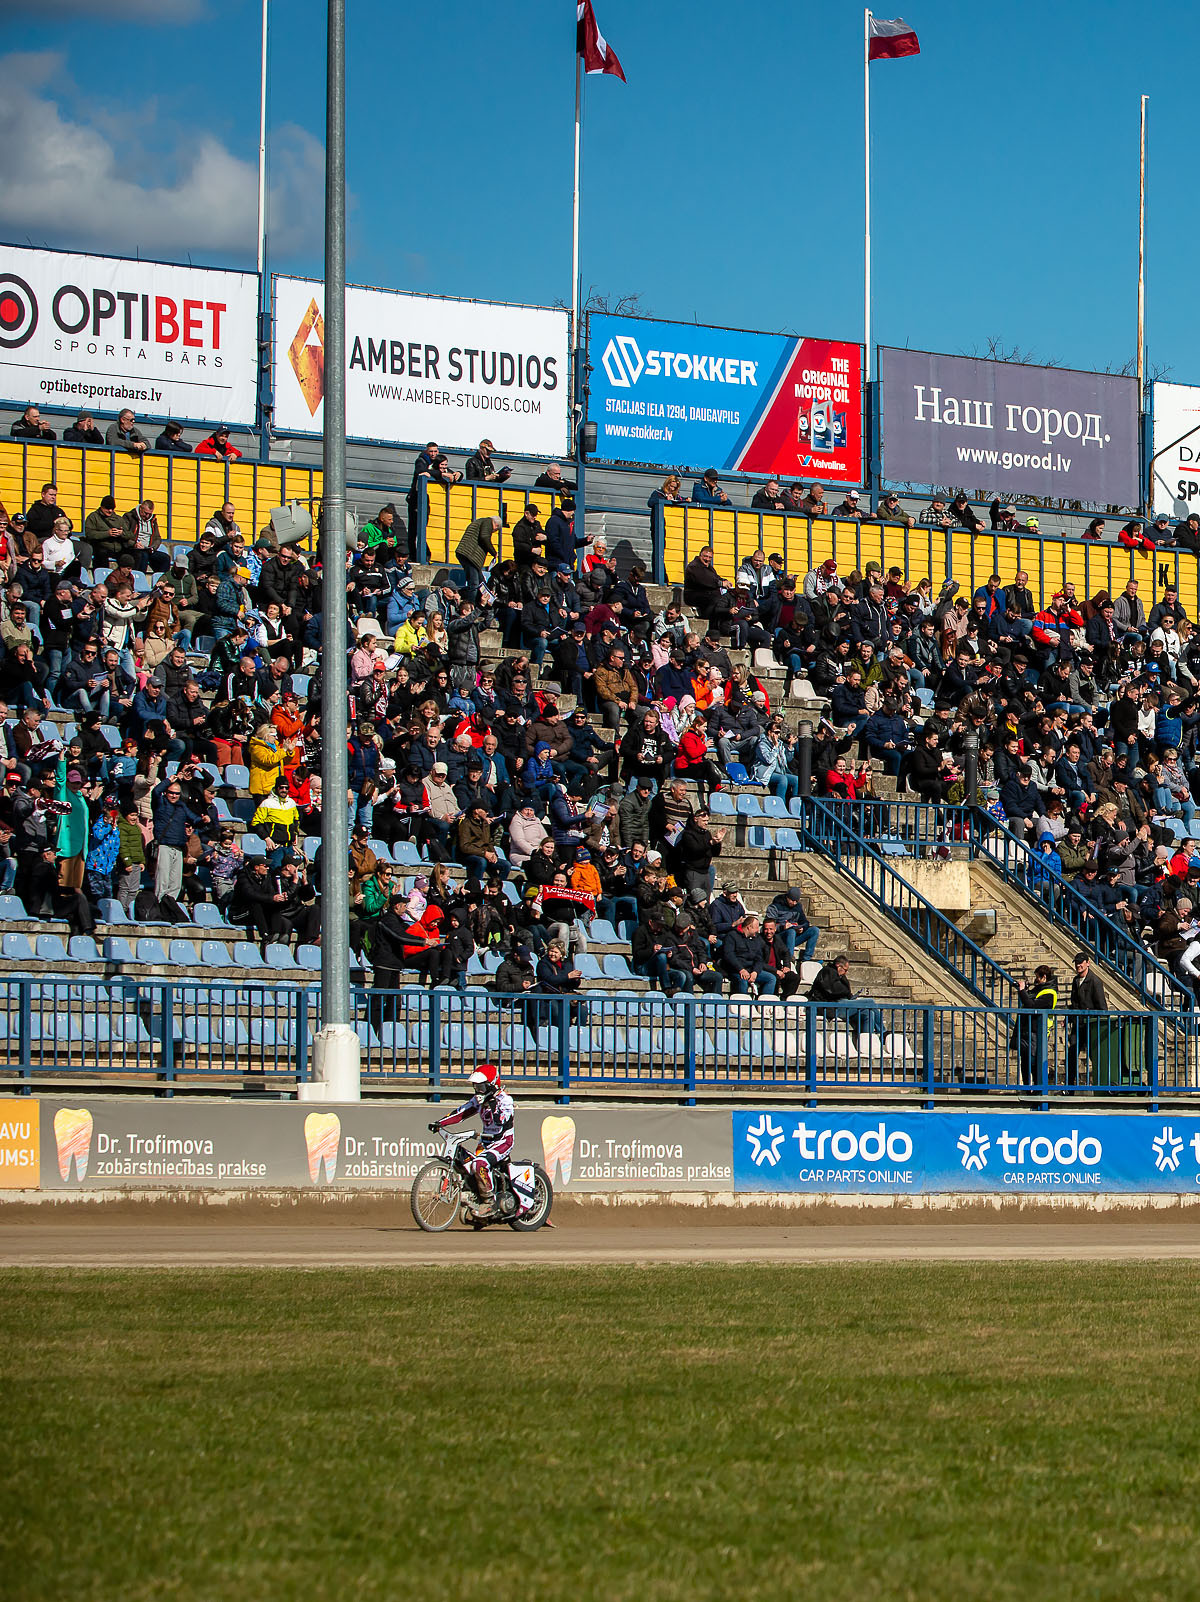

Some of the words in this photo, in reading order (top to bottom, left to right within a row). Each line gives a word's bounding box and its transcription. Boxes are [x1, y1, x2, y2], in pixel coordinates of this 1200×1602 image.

[52, 284, 227, 350] OPTIBET
[54, 338, 148, 361] SPORTA
[165, 349, 224, 369] BĀRS
[349, 335, 441, 380] AMBER
[447, 347, 559, 391] STUDIOS
[645, 350, 757, 386] STOKKER
[830, 357, 850, 373] THE
[802, 369, 850, 389] ORIGINAL
[40, 378, 163, 403] optibetsportabars.lv
[368, 382, 542, 414] WWW.AMBER-STUDIOS.COM
[794, 384, 832, 401] MOTOR
[833, 388, 850, 404] OIL
[605, 398, 646, 416] STACIJAS
[646, 402, 665, 418] IELA
[666, 404, 688, 422] 129d,
[689, 407, 740, 425] DAUGAVPILS
[913, 384, 993, 430] Наш
[1005, 403, 1111, 449] город.
[605, 423, 673, 442] www.stokker.lv
[956, 446, 1072, 474] www.gorod.lv
[1159, 563, 1169, 587] K
[0, 1122, 30, 1139] AVU
[97, 1134, 122, 1154] Dr.
[126, 1134, 214, 1155] Trofimova
[345, 1136, 368, 1156] Dr.
[371, 1136, 446, 1157] Trofimov
[579, 1139, 602, 1158] Dr.
[605, 1139, 683, 1159] Trofimova
[792, 1122, 913, 1163] trodo
[996, 1129, 1102, 1165] trodo
[97, 1159, 214, 1176] zobārstniecības
[218, 1160, 267, 1179] prakse
[580, 1161, 684, 1178] zobārstniecības
[687, 1163, 731, 1181] prakse
[799, 1169, 825, 1182] CAR
[826, 1169, 866, 1183] PARTS
[867, 1169, 913, 1184] ONLINE
[1003, 1172, 1025, 1184] CAR
[1027, 1172, 1060, 1184] PARTS
[1062, 1172, 1101, 1184] ONLINE
